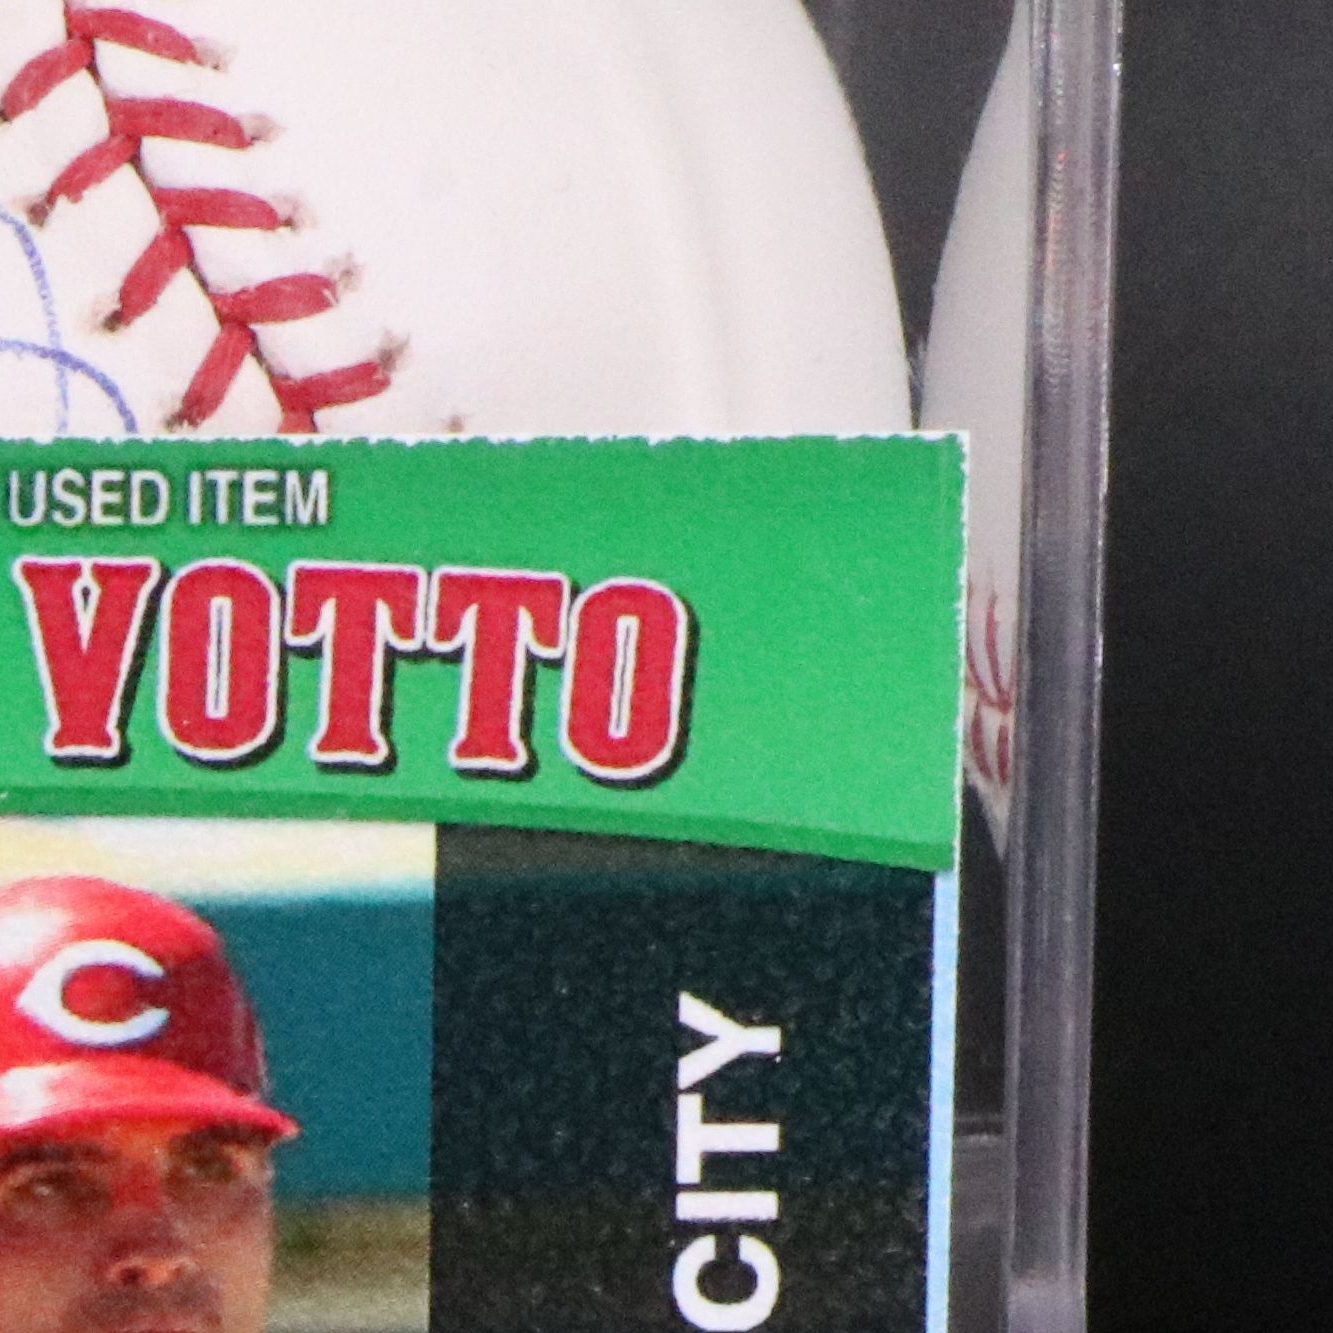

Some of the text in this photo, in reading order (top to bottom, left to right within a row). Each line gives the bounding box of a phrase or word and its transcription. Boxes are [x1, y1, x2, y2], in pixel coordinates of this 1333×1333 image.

[8, 467, 171, 527] USED
[189, 468, 331, 527] ITEM
[9, 557, 693, 786] VOTTO
